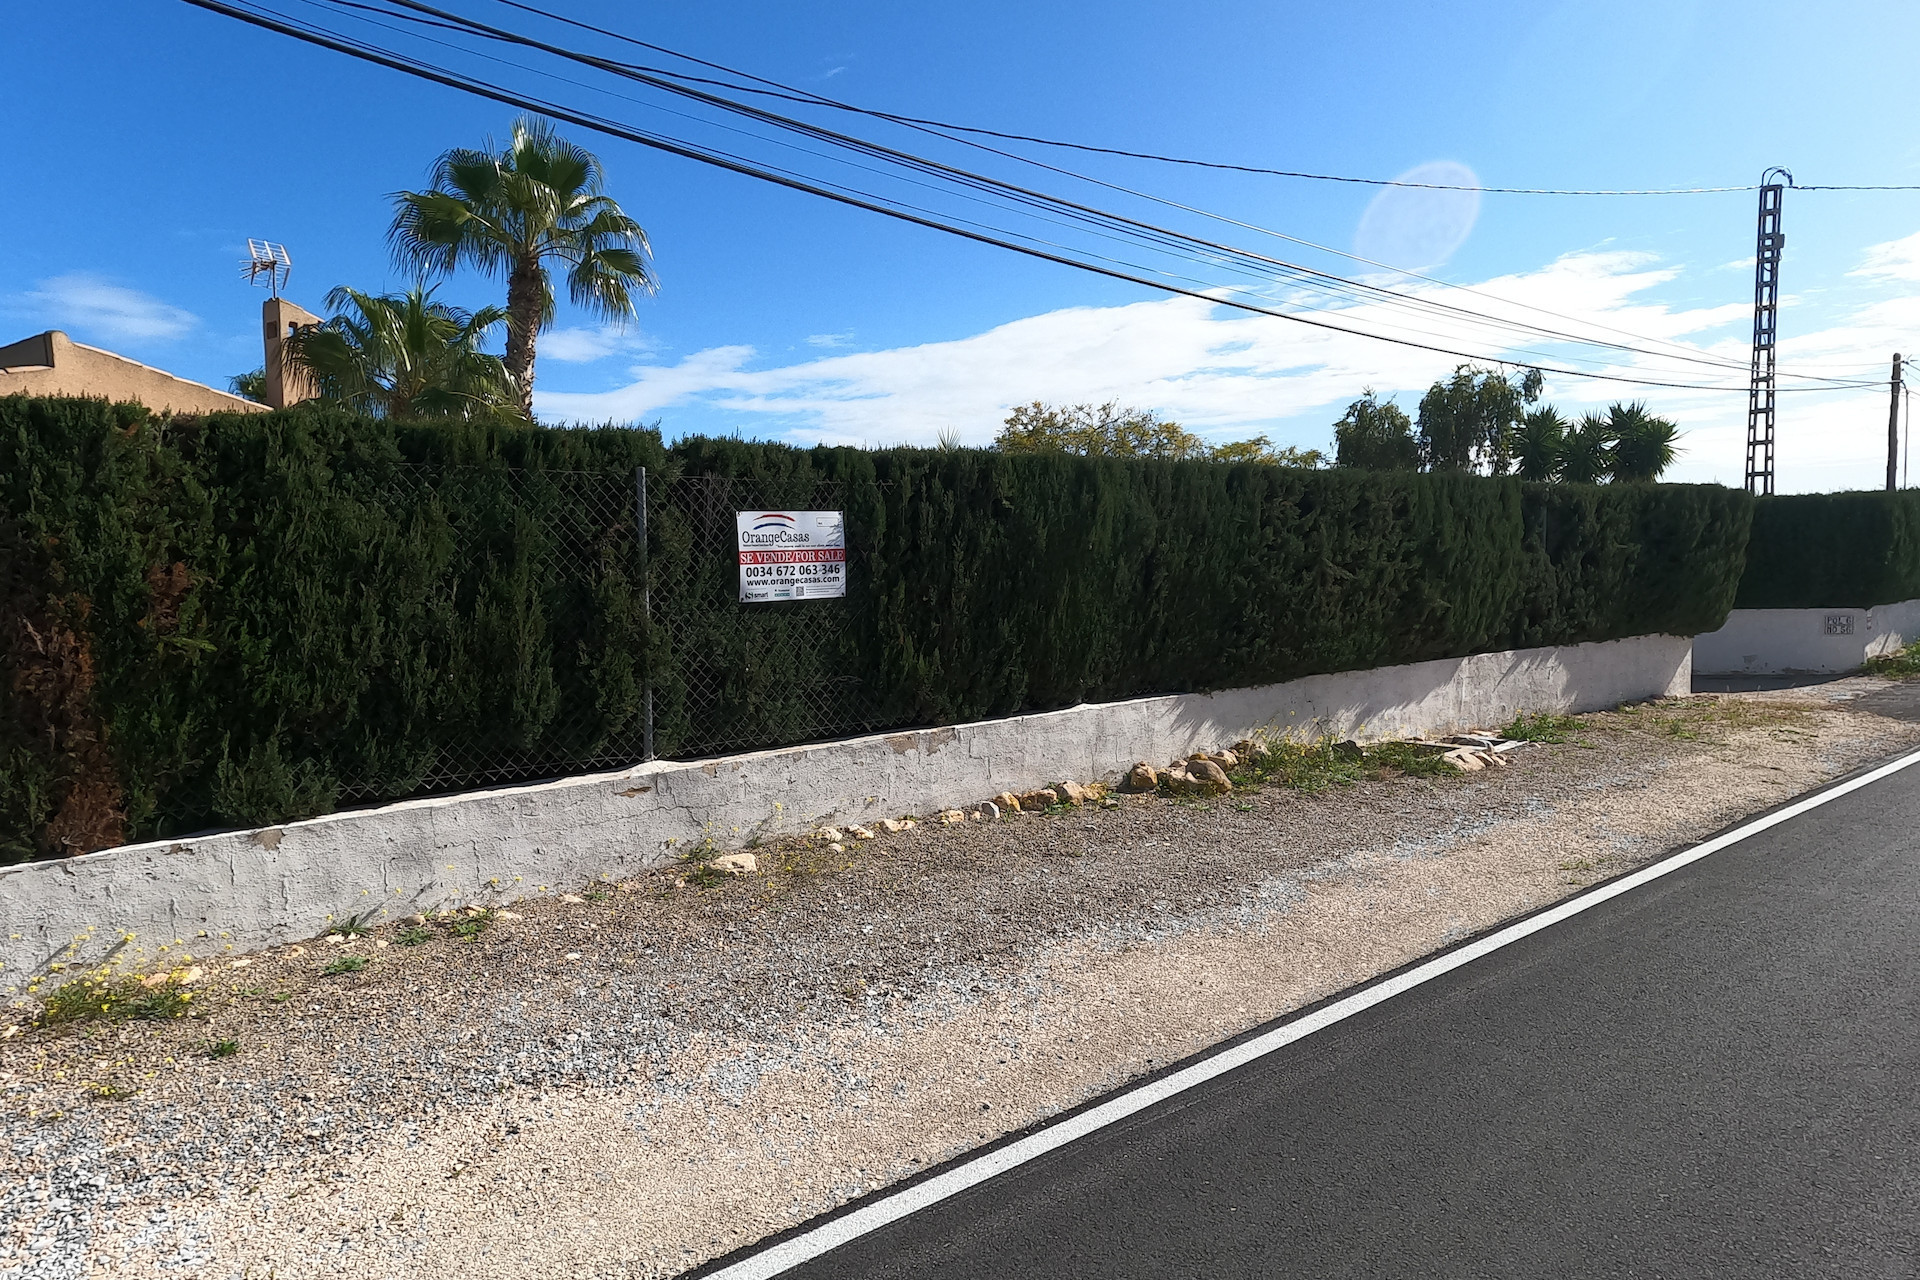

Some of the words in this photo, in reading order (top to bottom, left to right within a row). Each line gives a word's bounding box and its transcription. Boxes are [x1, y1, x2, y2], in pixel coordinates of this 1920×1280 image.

[742, 530, 810, 546] OrangeCasas
[740, 553, 754, 564] SE
[818, 550, 844, 561] SALE
[746, 566, 773, 577] 0034
[776, 565, 796, 576] 672
[799, 565, 818, 575] 063
[821, 564, 840, 574] 346
[746, 576, 840, 587] www.orangecasas.com
